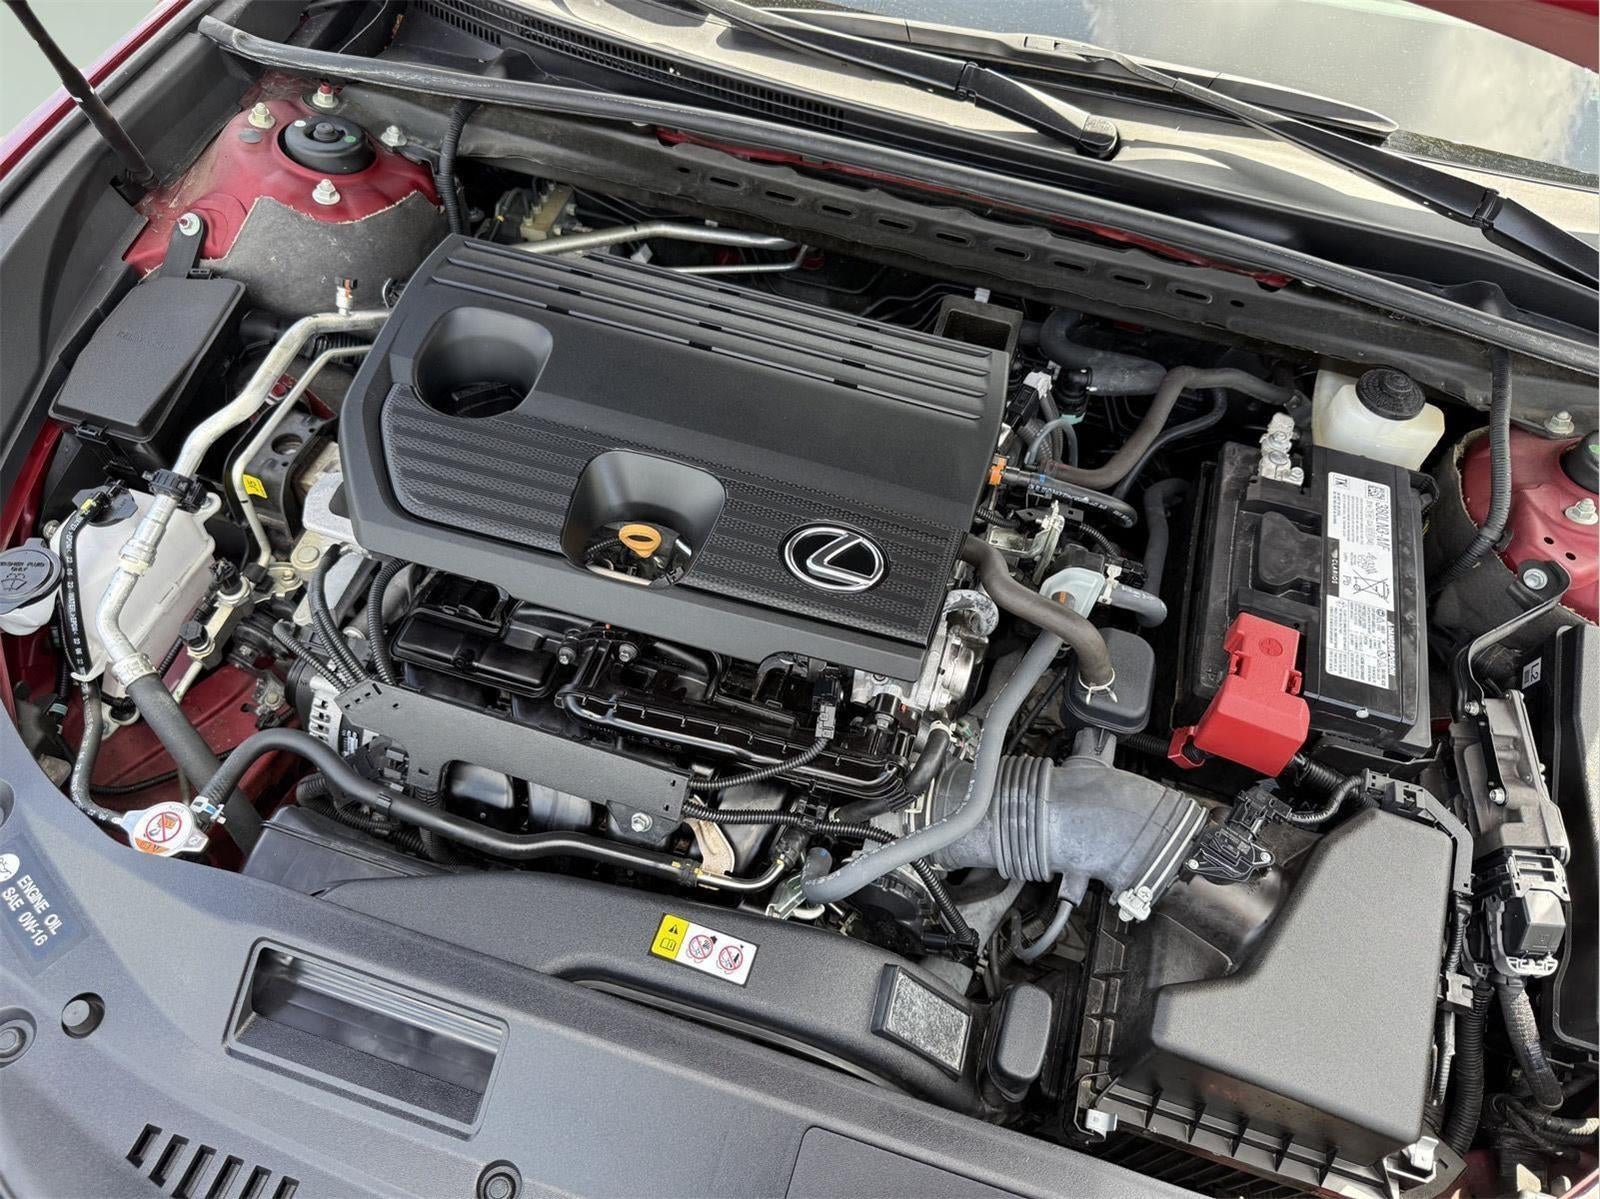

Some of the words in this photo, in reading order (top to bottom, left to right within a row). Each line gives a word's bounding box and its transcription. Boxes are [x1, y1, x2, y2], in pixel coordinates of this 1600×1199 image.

[1331, 559, 1339, 585] CLARIOS
[1, 886, 25, 912] SAE
[18, 911, 49, 947] 0W-16
[17, 874, 51, 915] ENGINE
[43, 913, 64, 936] OIL
